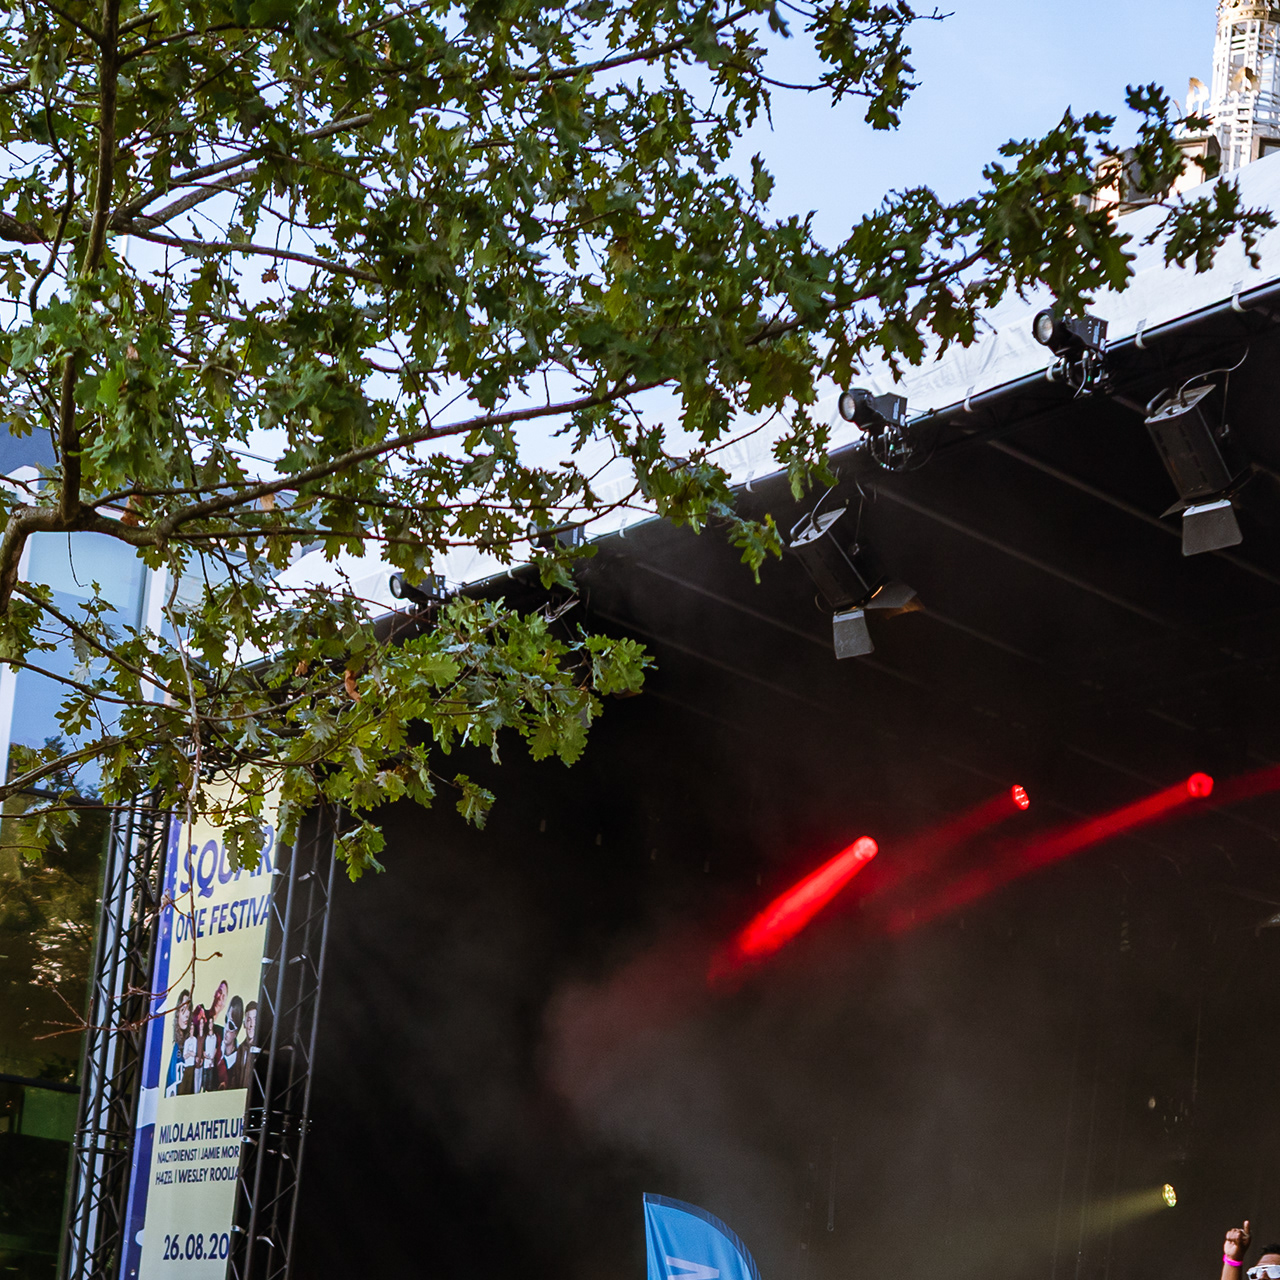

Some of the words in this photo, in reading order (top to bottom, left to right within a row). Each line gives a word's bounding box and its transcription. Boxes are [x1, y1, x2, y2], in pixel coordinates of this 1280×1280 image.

[180, 825, 274, 898] SQUR
[176, 908, 207, 943] ONE
[209, 894, 271, 936] FESTIVA
[221, 1145, 239, 1158] MOR
[163, 1232, 230, 1260] 26.08.20
